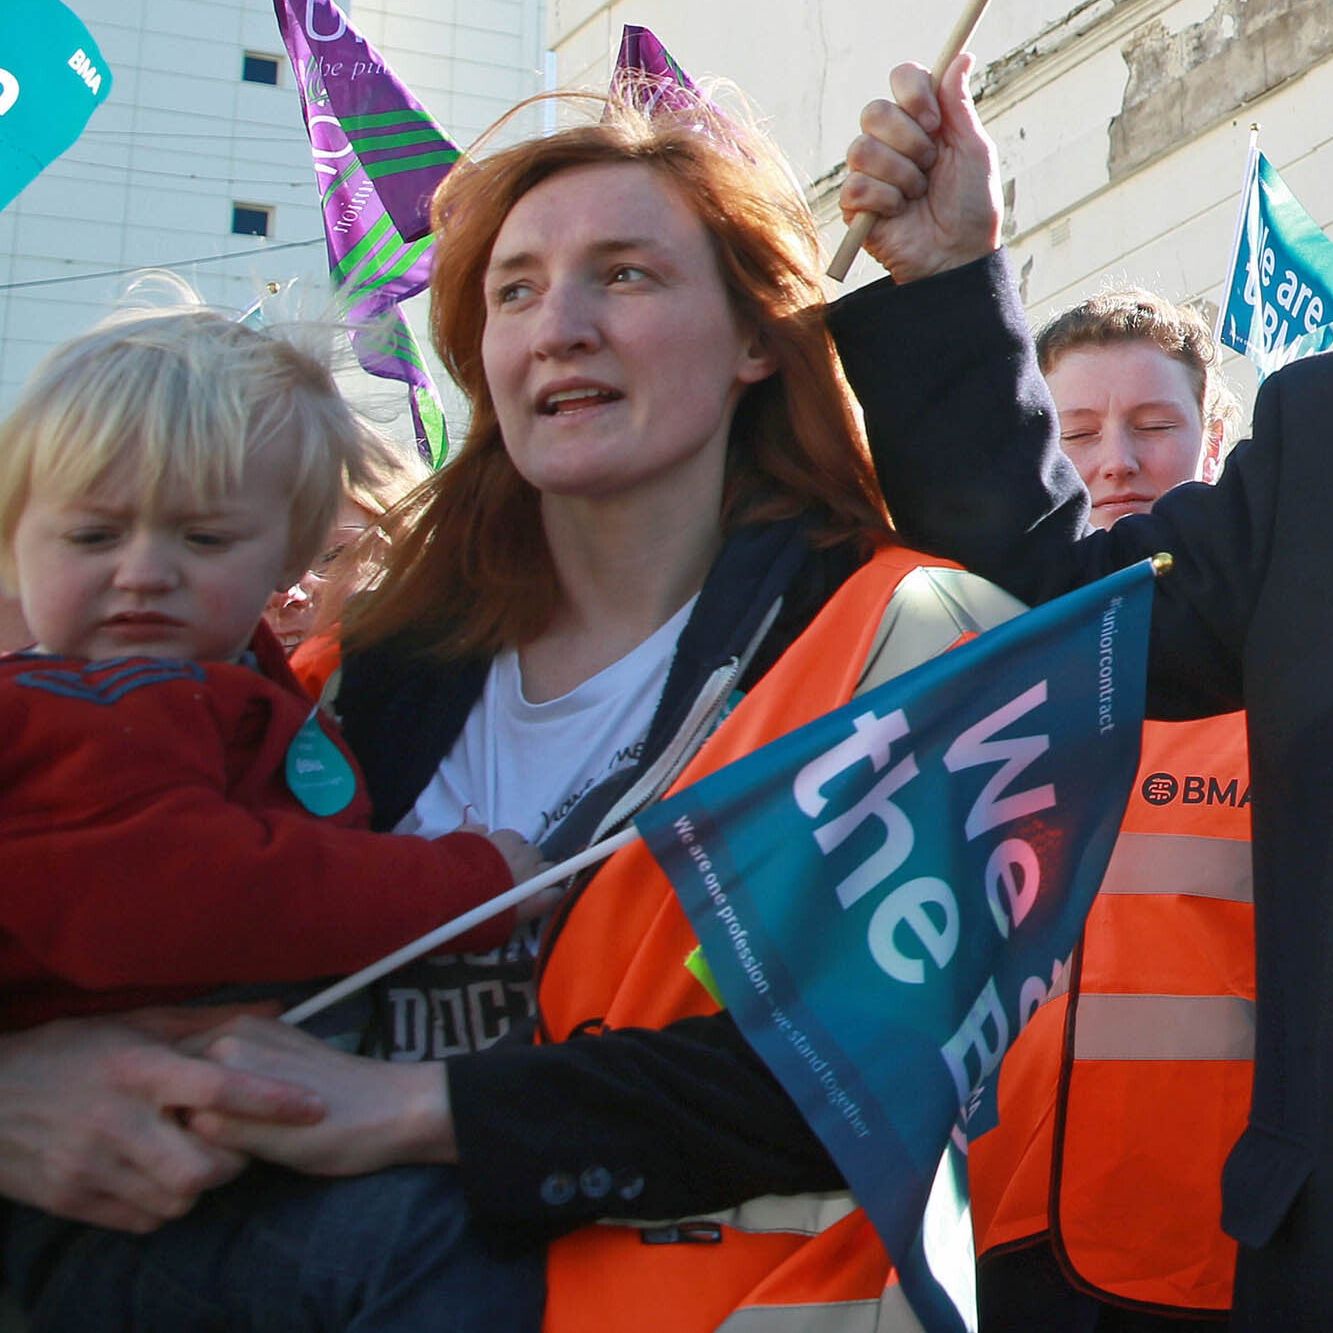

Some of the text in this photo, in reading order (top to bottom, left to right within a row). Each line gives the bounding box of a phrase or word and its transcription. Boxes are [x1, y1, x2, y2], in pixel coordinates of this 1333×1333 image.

[67, 48, 101, 96] BMA
[1276, 269, 1324, 332] are
[792, 707, 961, 985] the
[942, 678, 1057, 941] We
[673, 815, 695, 844] We
[689, 842, 713, 873] are
[704, 872, 728, 906] one
[717, 904, 771, 996] profession
[789, 1027, 827, 1075] stand
